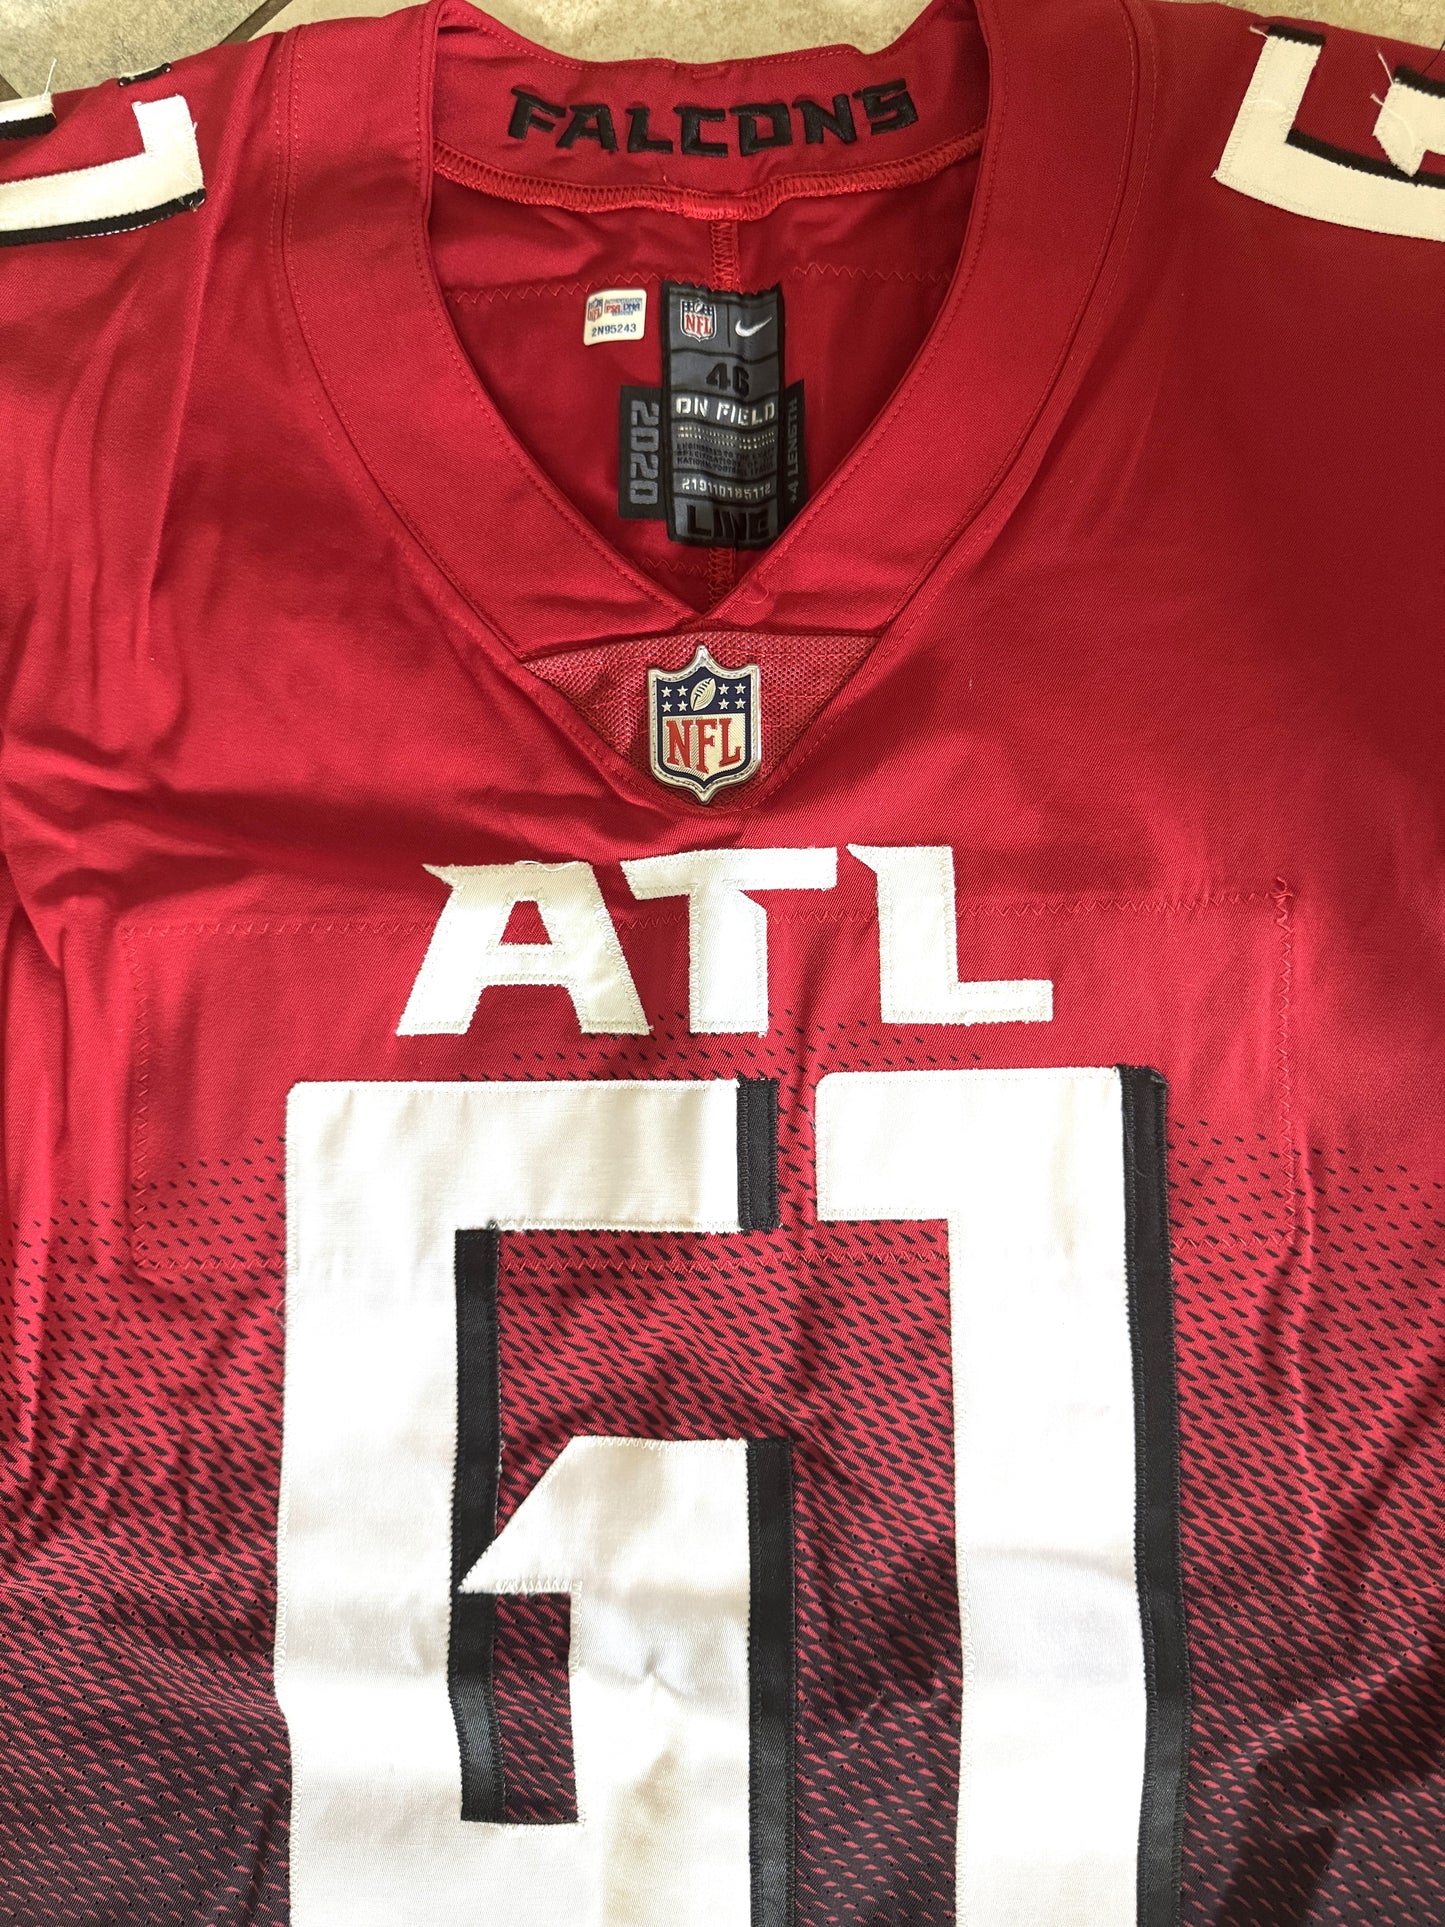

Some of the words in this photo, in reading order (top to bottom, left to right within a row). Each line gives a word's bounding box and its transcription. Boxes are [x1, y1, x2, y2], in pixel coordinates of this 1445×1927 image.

[508, 79, 919, 157] FALCONS
[591, 323, 637, 338] 2N95243
[685, 314, 712, 337] NFL
[676, 397, 708, 418] ON
[716, 402, 775, 426] FIELD
[706, 362, 750, 398] 46
[630, 400, 660, 505] 2020
[787, 397, 799, 477] LENGTH
[665, 716, 743, 774] NFL
[396, 844, 1053, 1036] ATL
[275, 1066, 1191, 1927] 61
